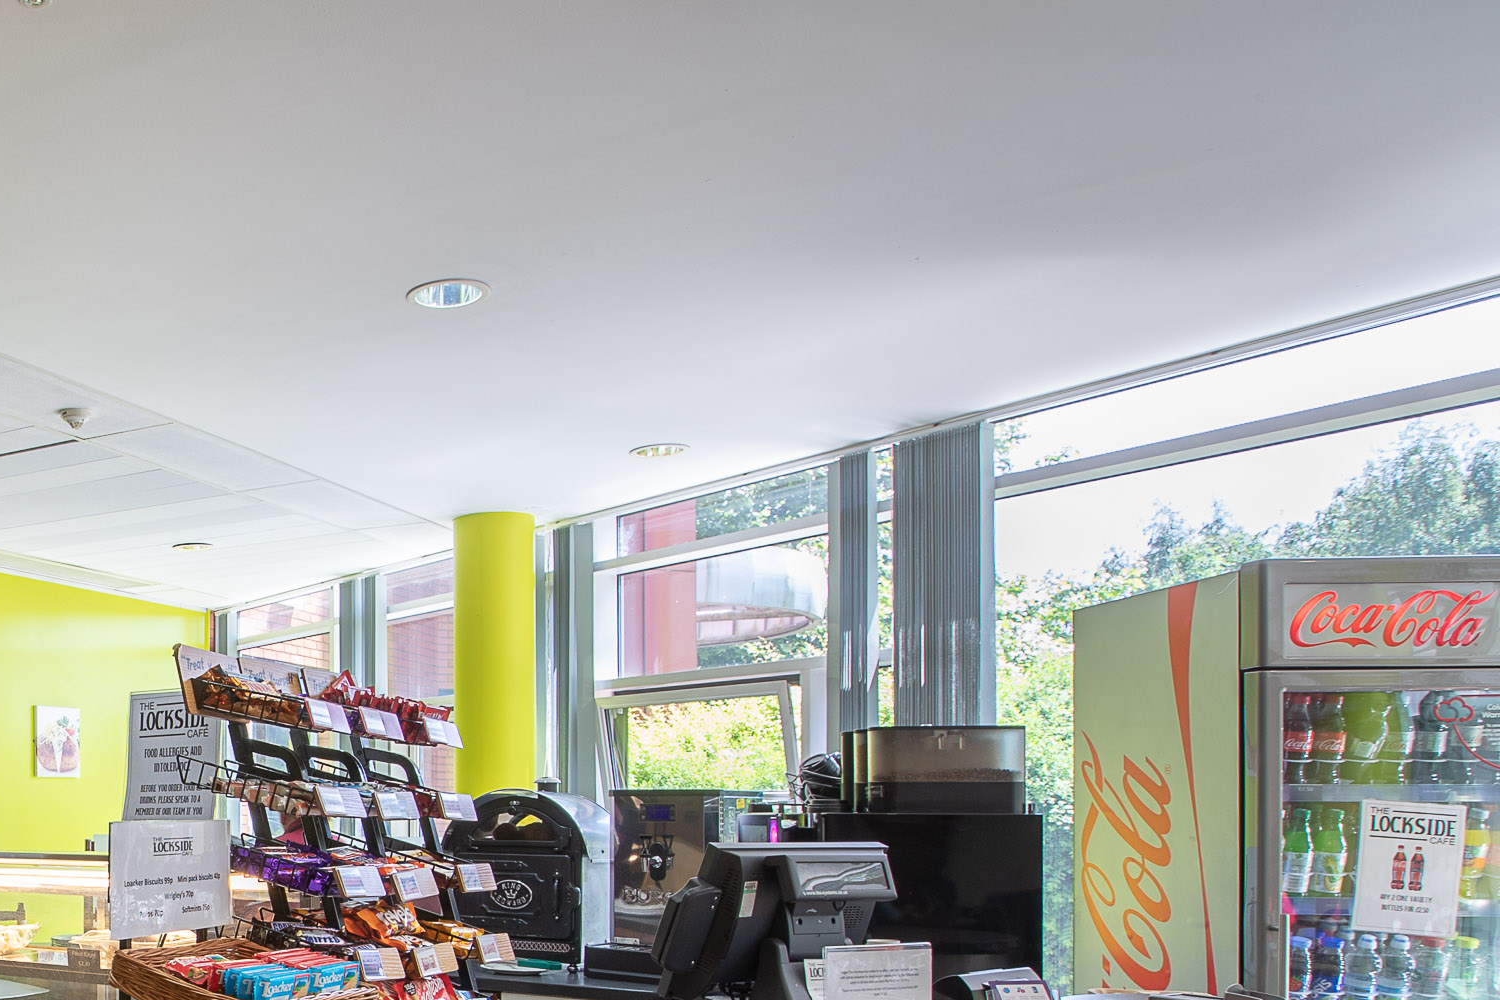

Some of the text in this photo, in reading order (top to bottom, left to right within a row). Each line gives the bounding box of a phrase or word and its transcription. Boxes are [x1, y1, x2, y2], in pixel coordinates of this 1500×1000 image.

[1289, 588, 1497, 649] Coca-Cola
[140, 702, 154, 710] THE
[140, 709, 208, 731] LOCKSIDE
[144, 746, 202, 758] FOOD ALLERGIES AND
[140, 784, 157, 793] BEFORE
[158, 784, 167, 792] YOU
[168, 784, 182, 792] ORDER
[157, 795, 174, 804] PLEASE
[174, 795, 189, 803] SPEAK
[190, 795, 197, 803] TO
[197, 795, 201, 803] A
[134, 807, 203, 816] MEMBER OF OUR TEAM IF YOU
[1370, 806, 1389, 814] THE
[1369, 815, 1457, 837] LOCKSIDE
[153, 841, 193, 853] LOCKSIDE
[124, 879, 143, 887] Loacker
[144, 878, 163, 886] Biscuits
[164, 877, 173, 885] 99p
[188, 875, 197, 883] pack
[502, 881, 521, 890] KING
[186, 891, 194, 899] 70p
[496, 894, 527, 906] EDWARD
[622, 886, 672, 905] BURC
[182, 904, 201, 913] Softmints
[1381, 904, 1403, 912] BOTTLES
[1404, 904, 1414, 912] FOR
[376, 907, 415, 926] revels
[311, 971, 344, 988] Loacker
[259, 979, 294, 997] Loacker
